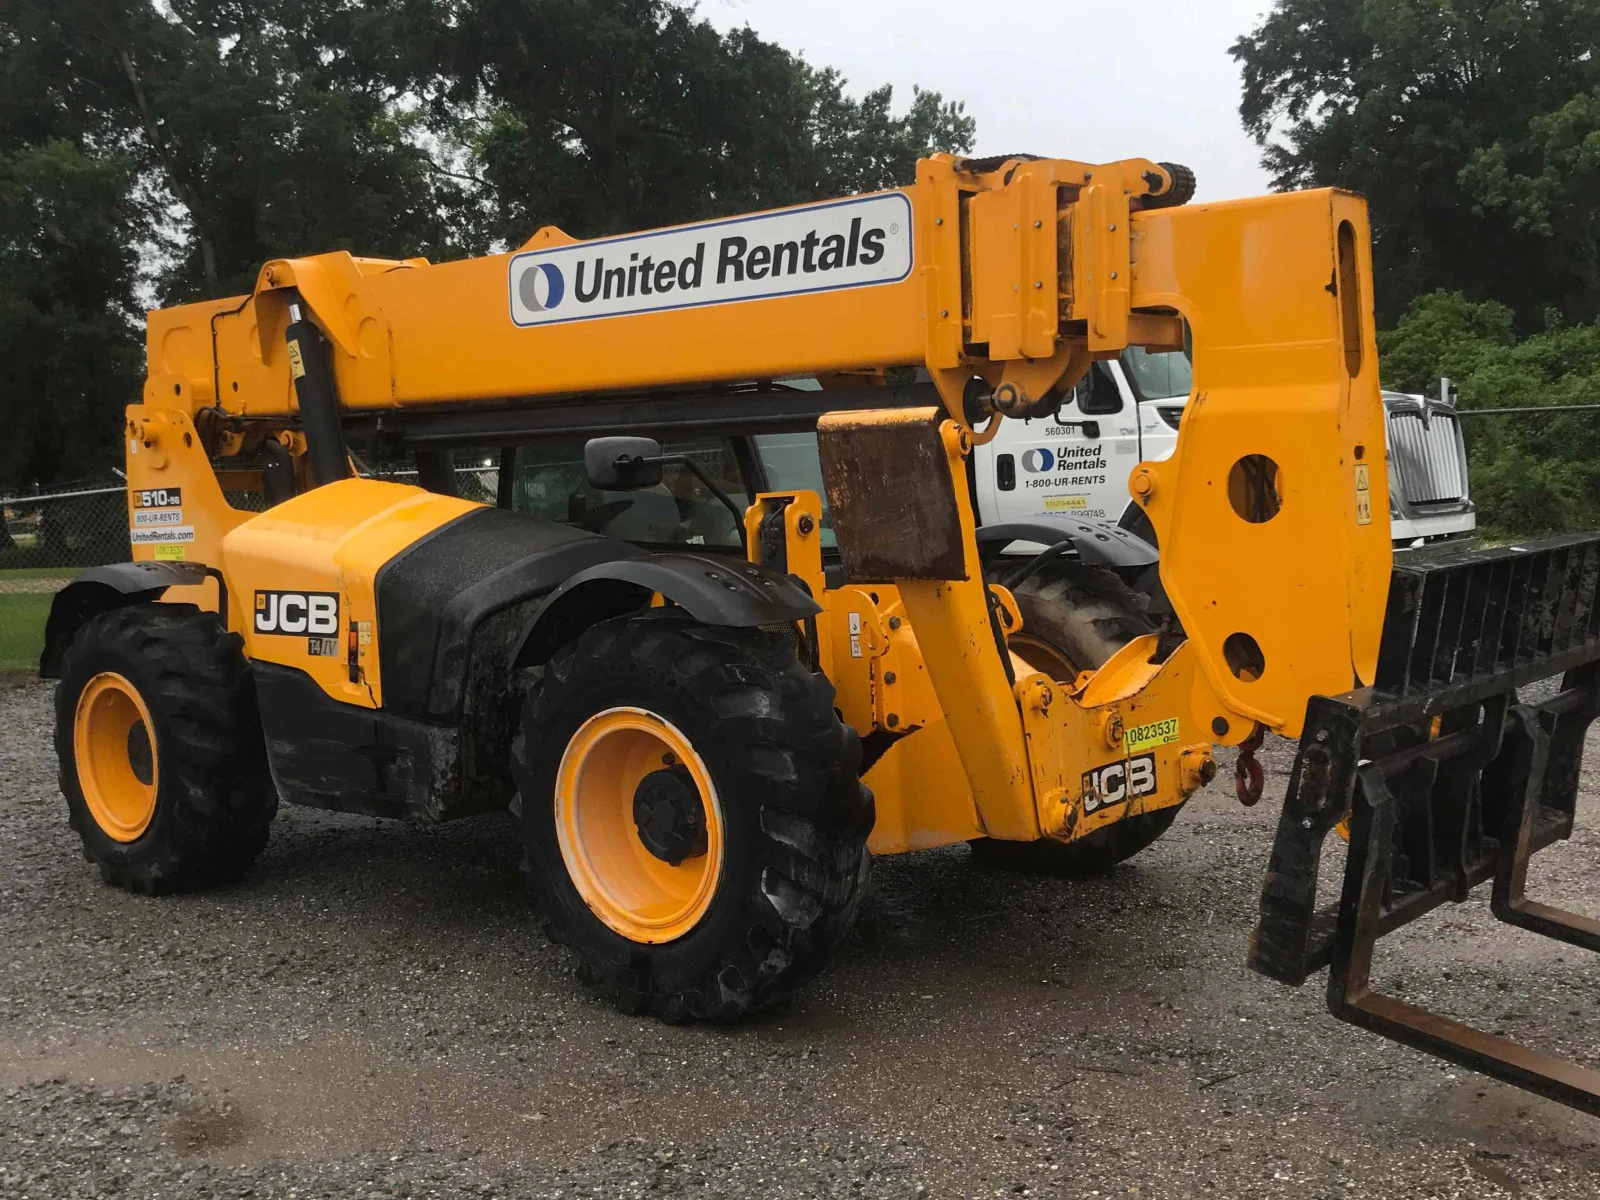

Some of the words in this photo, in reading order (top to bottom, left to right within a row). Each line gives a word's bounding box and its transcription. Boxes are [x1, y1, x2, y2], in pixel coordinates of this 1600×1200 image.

[574, 242, 705, 304] United
[716, 217, 885, 284] Rentals
[1045, 426, 1075, 436] 560301
[1057, 444, 1102, 458] United
[1057, 457, 1107, 471] Rentals
[1025, 475, 1106, 488] 1-800-UR-RENTS
[142, 490, 180, 506] 510-56
[132, 529, 194, 542] UnitedRentals.com
[256, 594, 338, 634] JCB
[1124, 719, 1177, 743] 10823537
[1084, 757, 1155, 811] JCB
